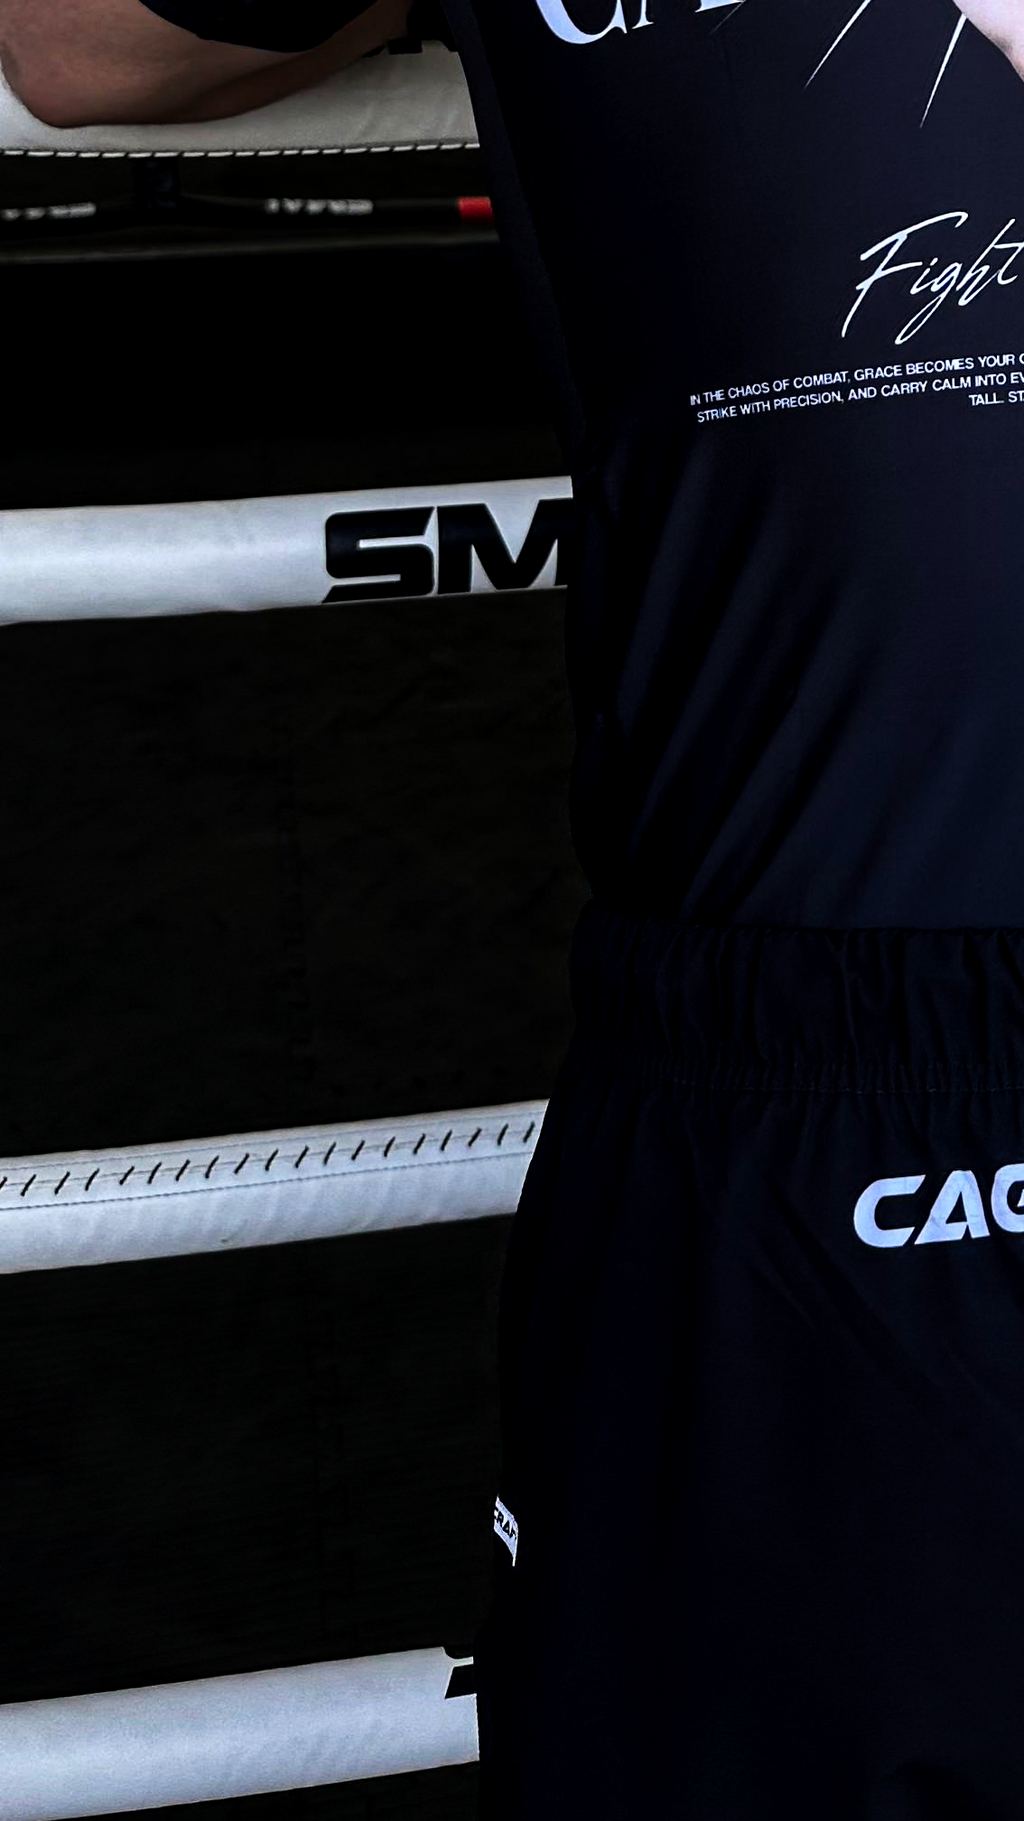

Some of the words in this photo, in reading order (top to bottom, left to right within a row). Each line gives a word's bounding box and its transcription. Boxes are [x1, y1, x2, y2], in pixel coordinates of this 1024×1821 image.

[690, 395, 701, 406] IN
[703, 389, 726, 404] THE
[727, 382, 770, 400] CHAOS
[772, 379, 791, 391] OF
[793, 370, 851, 389] COMBAT,
[854, 364, 903, 381] GRACE
[906, 357, 975, 376] BECOMES
[978, 354, 1016, 368] YOUR
[697, 405, 738, 423] STRIKE
[739, 400, 771, 415] WITH
[774, 390, 844, 409] PRECISION,
[848, 387, 877, 401] AND
[880, 380, 929, 397] CARRY
[932, 376, 972, 392] CALM
[974, 373, 1007, 387] INTO
